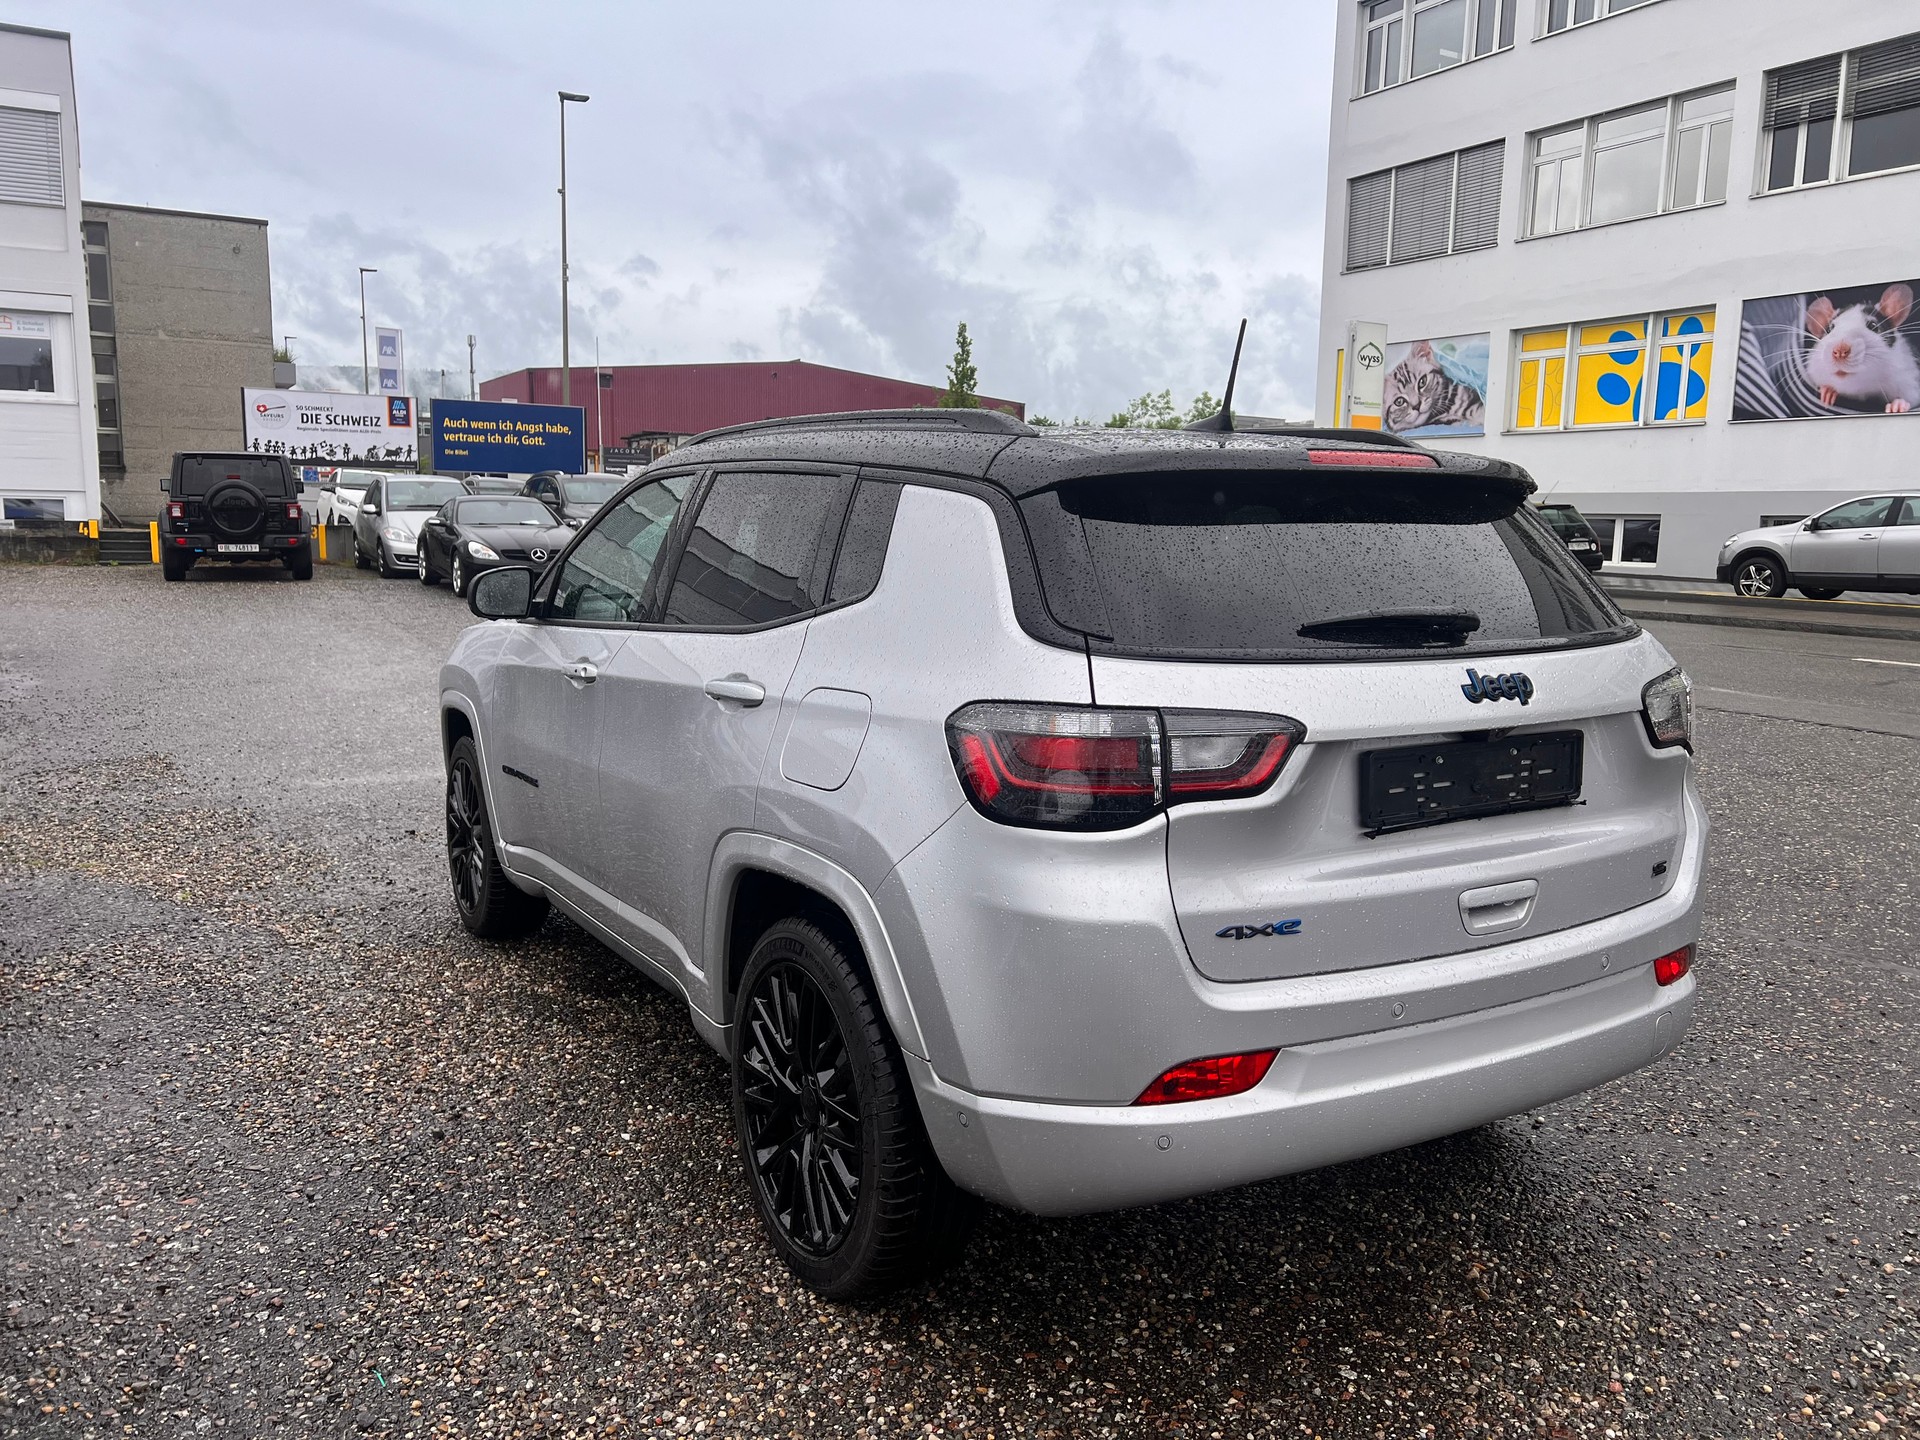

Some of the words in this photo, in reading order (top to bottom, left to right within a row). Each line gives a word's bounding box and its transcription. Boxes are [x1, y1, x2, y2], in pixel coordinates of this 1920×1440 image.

[1360, 354, 1380, 370] wyss
[301, 413, 322, 425] DIE
[326, 414, 381, 427] SCHWEIZ
[443, 417, 468, 428] Auch
[470, 421, 496, 430] wenn
[499, 419, 513, 431] ich
[516, 421, 543, 434] Angst
[545, 422, 572, 435] habe,
[443, 432, 485, 442] vertraue
[487, 432, 502, 443] ich
[504, 433, 520, 446] dir,
[521, 435, 546, 446] Gott.
[1461, 668, 1534, 706] Jeep
